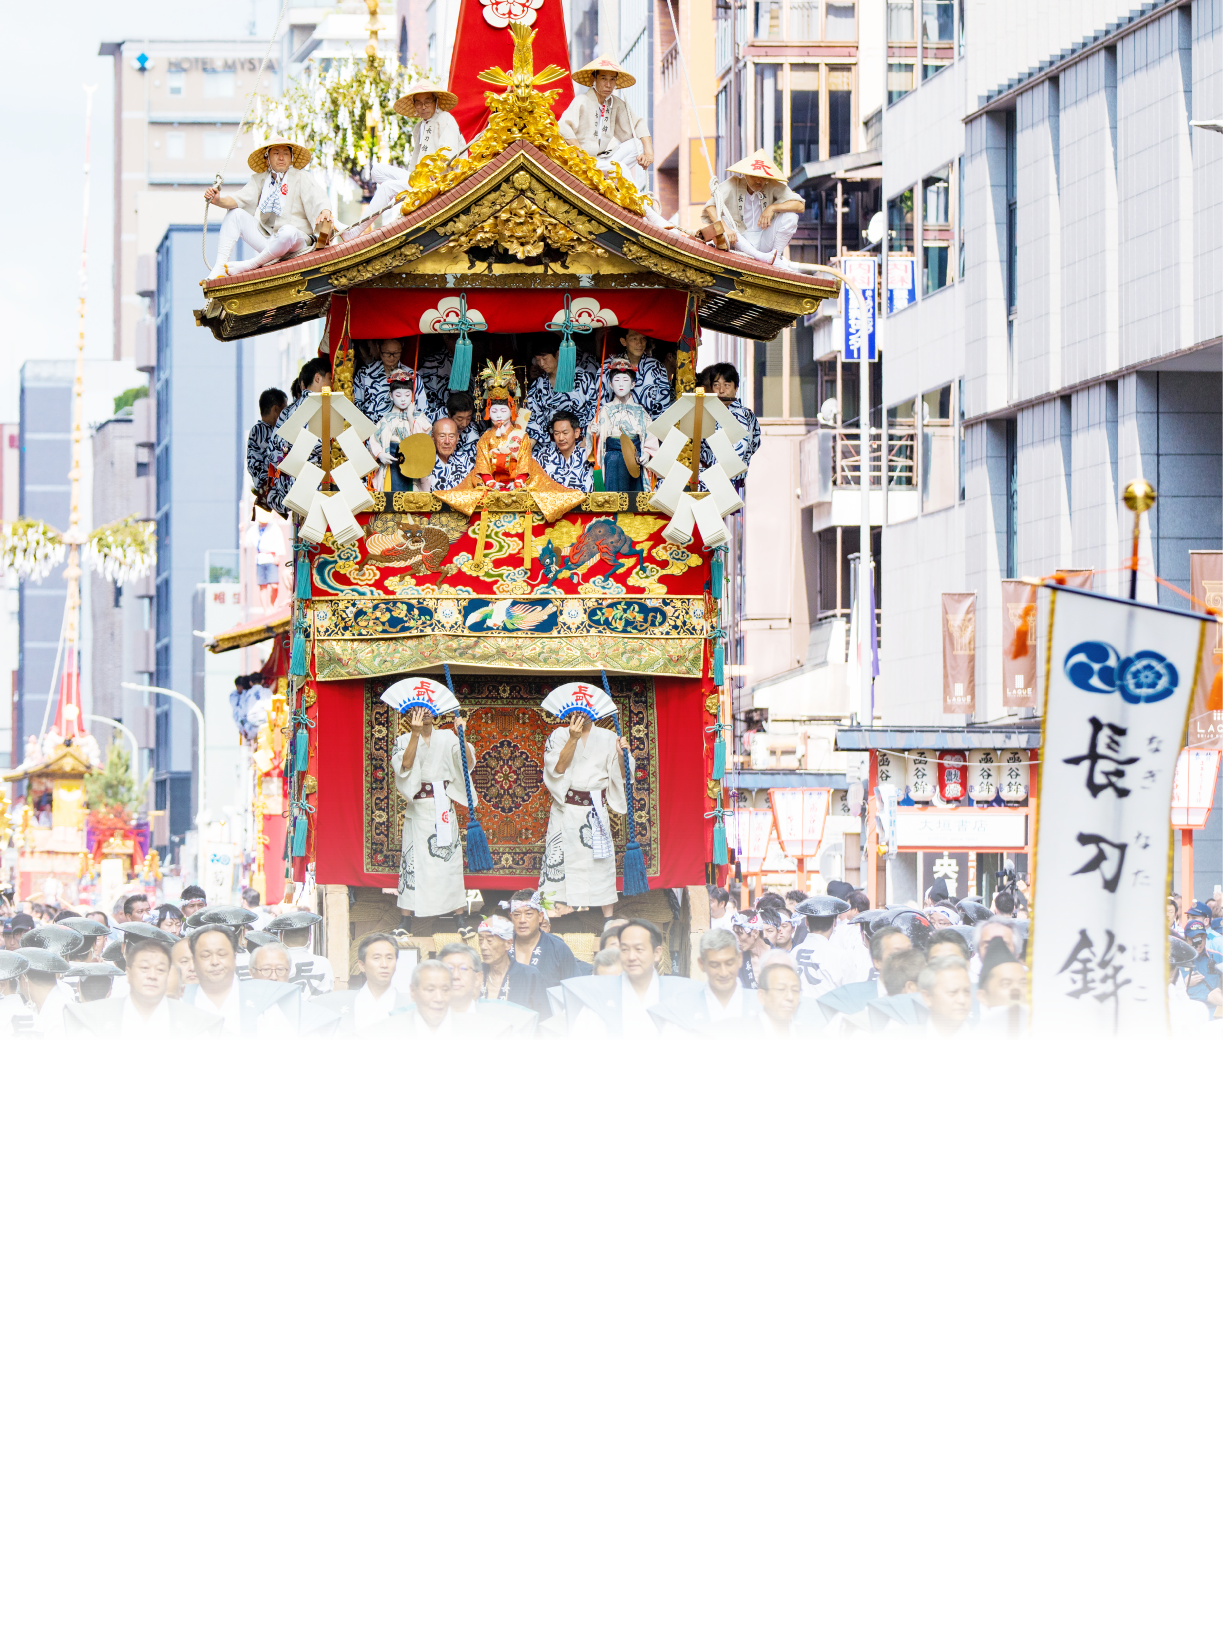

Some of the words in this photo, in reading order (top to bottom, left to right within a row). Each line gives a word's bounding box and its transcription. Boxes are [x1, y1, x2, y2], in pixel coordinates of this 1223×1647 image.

[168, 57, 217, 71] HOTEL
[913, 751, 928, 794] 函谷鉾
[979, 752, 994, 794] 函谷鉾
[1007, 751, 1022, 795] 函谷鉾
[918, 819, 988, 832] 大垣書店
[1053, 715, 1141, 1038] 長刀鉾
